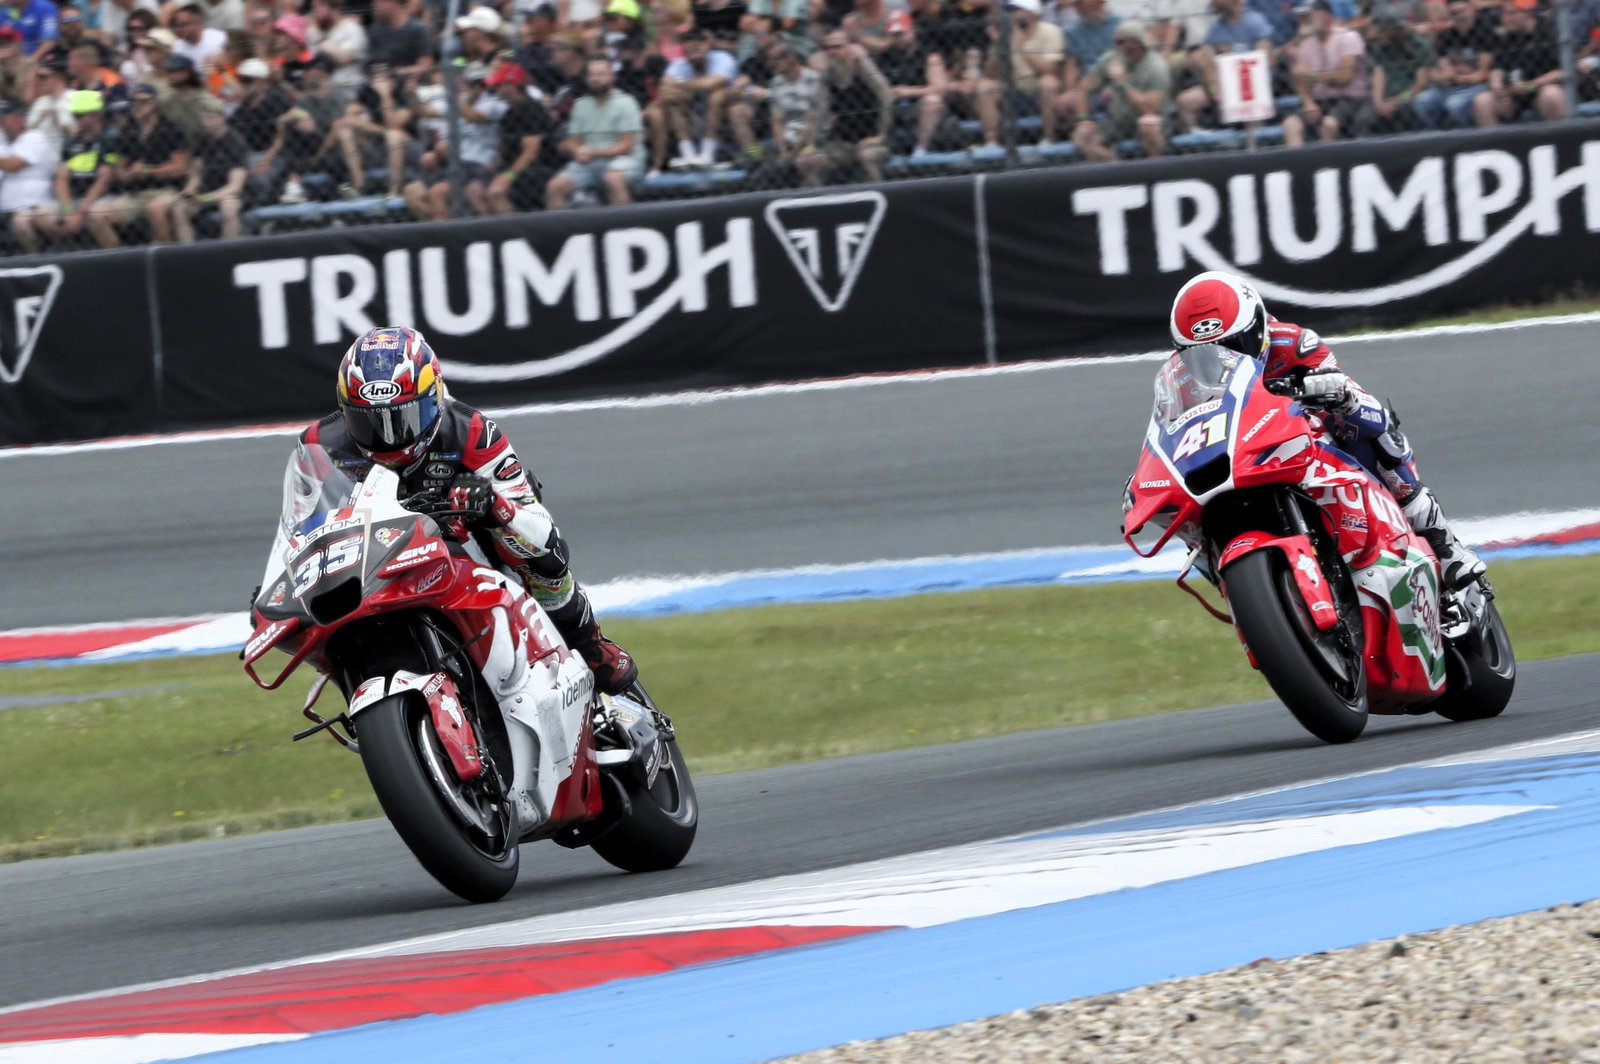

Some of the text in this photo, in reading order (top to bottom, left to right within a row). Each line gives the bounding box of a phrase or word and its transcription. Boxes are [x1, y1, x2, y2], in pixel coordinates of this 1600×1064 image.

[1072, 143, 1600, 308] TRIUMPH
[233, 216, 758, 381] TRIUMPH
[365, 384, 395, 396] Arai
[391, 400, 417, 411] WINGS
[1179, 401, 1220, 425] Castrol
[1172, 412, 1228, 463] 41
[1241, 408, 1280, 442] HONDA
[1138, 479, 1171, 489] HONDA
[385, 556, 431, 572] HONDA
[396, 541, 438, 561] GIVI
[292, 534, 364, 600] 35
[244, 622, 277, 656] GIVI
